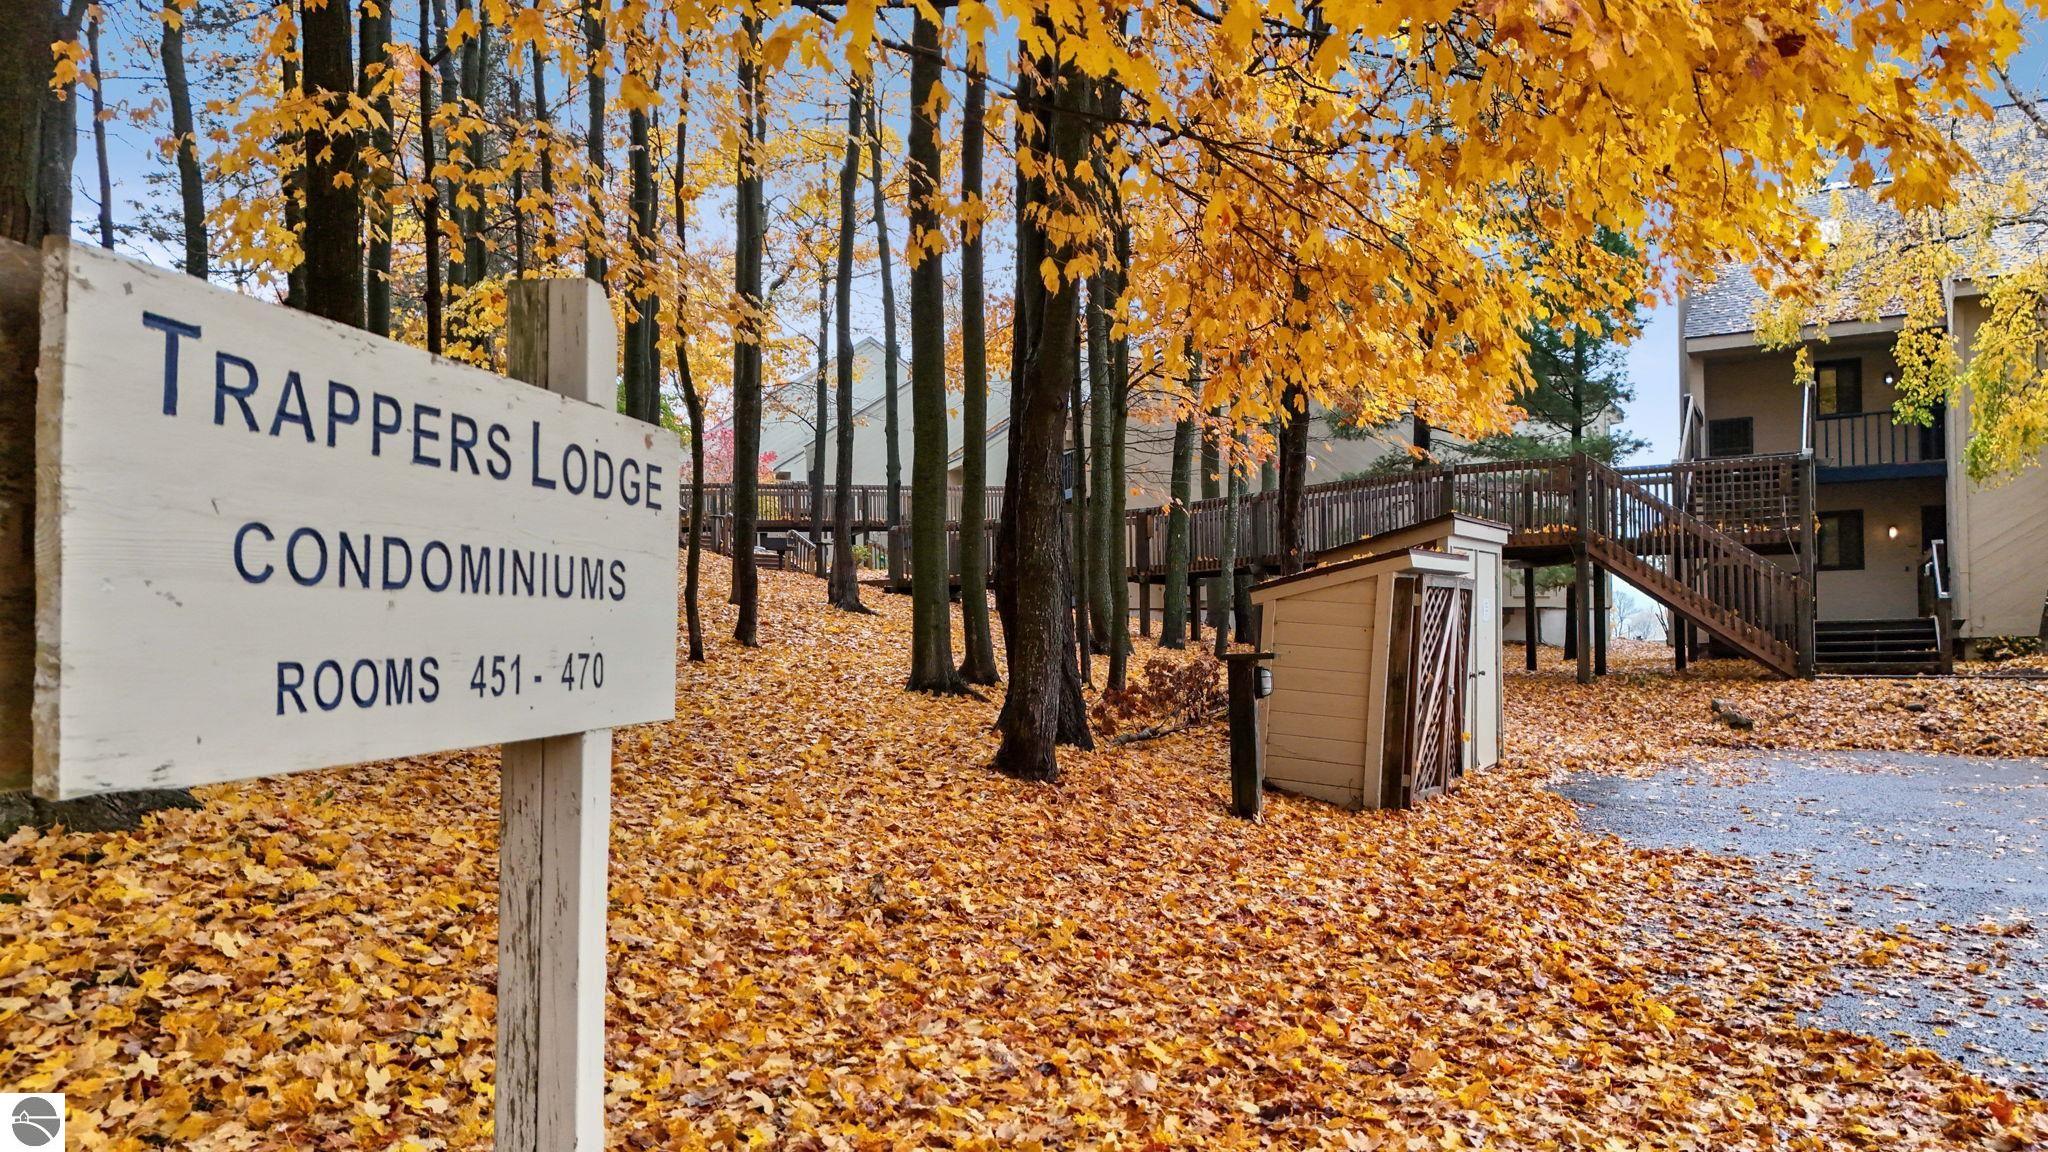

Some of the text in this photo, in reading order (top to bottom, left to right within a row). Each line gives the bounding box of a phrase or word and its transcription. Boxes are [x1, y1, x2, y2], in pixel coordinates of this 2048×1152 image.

[142, 310, 663, 511] TRAPPERS LODGE
[233, 521, 628, 602] CONDOMINIUMS
[276, 656, 441, 716] ROOMS
[470, 653, 521, 698] 451
[560, 652, 604, 692] 470
